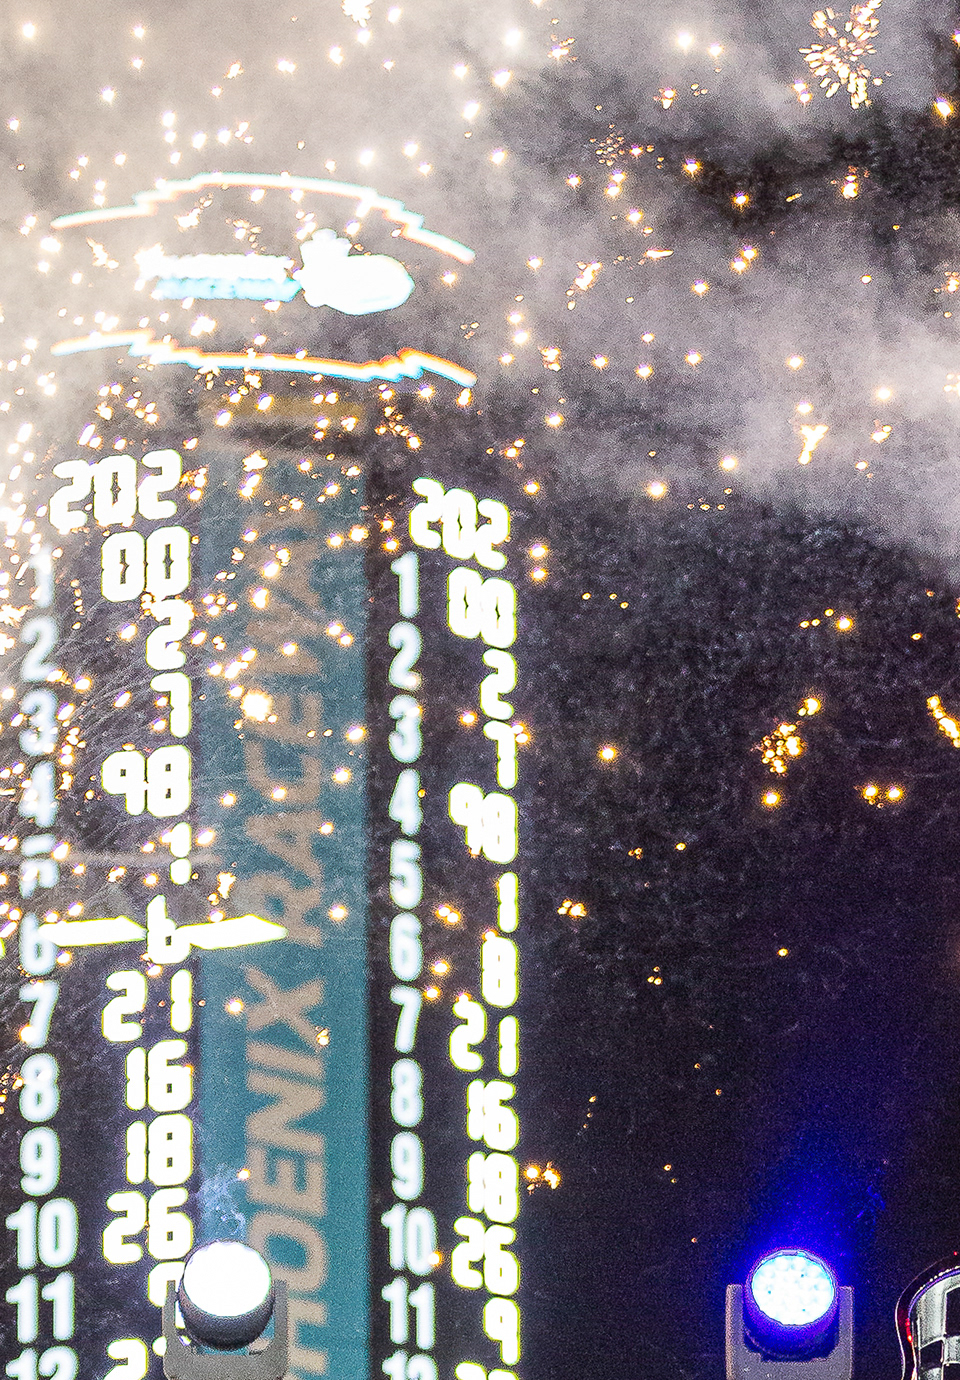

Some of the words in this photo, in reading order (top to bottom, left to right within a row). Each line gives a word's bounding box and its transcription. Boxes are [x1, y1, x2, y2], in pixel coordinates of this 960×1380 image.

[100, 525, 192, 602] 00
[390, 551, 421, 618] 1
[21, 616, 57, 681] 2
[146, 599, 193, 671] 2
[388, 621, 423, 688] 2
[480, 648, 518, 720] 2
[20, 688, 57, 757] 3
[388, 694, 424, 764] 3
[101, 744, 192, 818] 98
[388, 768, 424, 836] 4
[389, 838, 424, 910] 5
[389, 911, 424, 982] 6
[19, 979, 60, 1048] 7
[102, 969, 193, 1042] 21
[390, 984, 423, 1053] 7
[19, 1053, 60, 1122] 8
[125, 1039, 193, 1112] 16
[389, 1058, 424, 1127] 8
[19, 1126, 60, 1196] 9
[125, 1112, 194, 1186] 18
[390, 1131, 425, 1200] 9
[5, 1199, 79, 1269] 10
[102, 1187, 194, 1264] 26
[381, 1203, 439, 1276] 10
[450, 1216, 520, 1296] 26
[5, 1270, 76, 1344] 11
[381, 1276, 436, 1350] 11
[483, 1297, 520, 1366] 9
